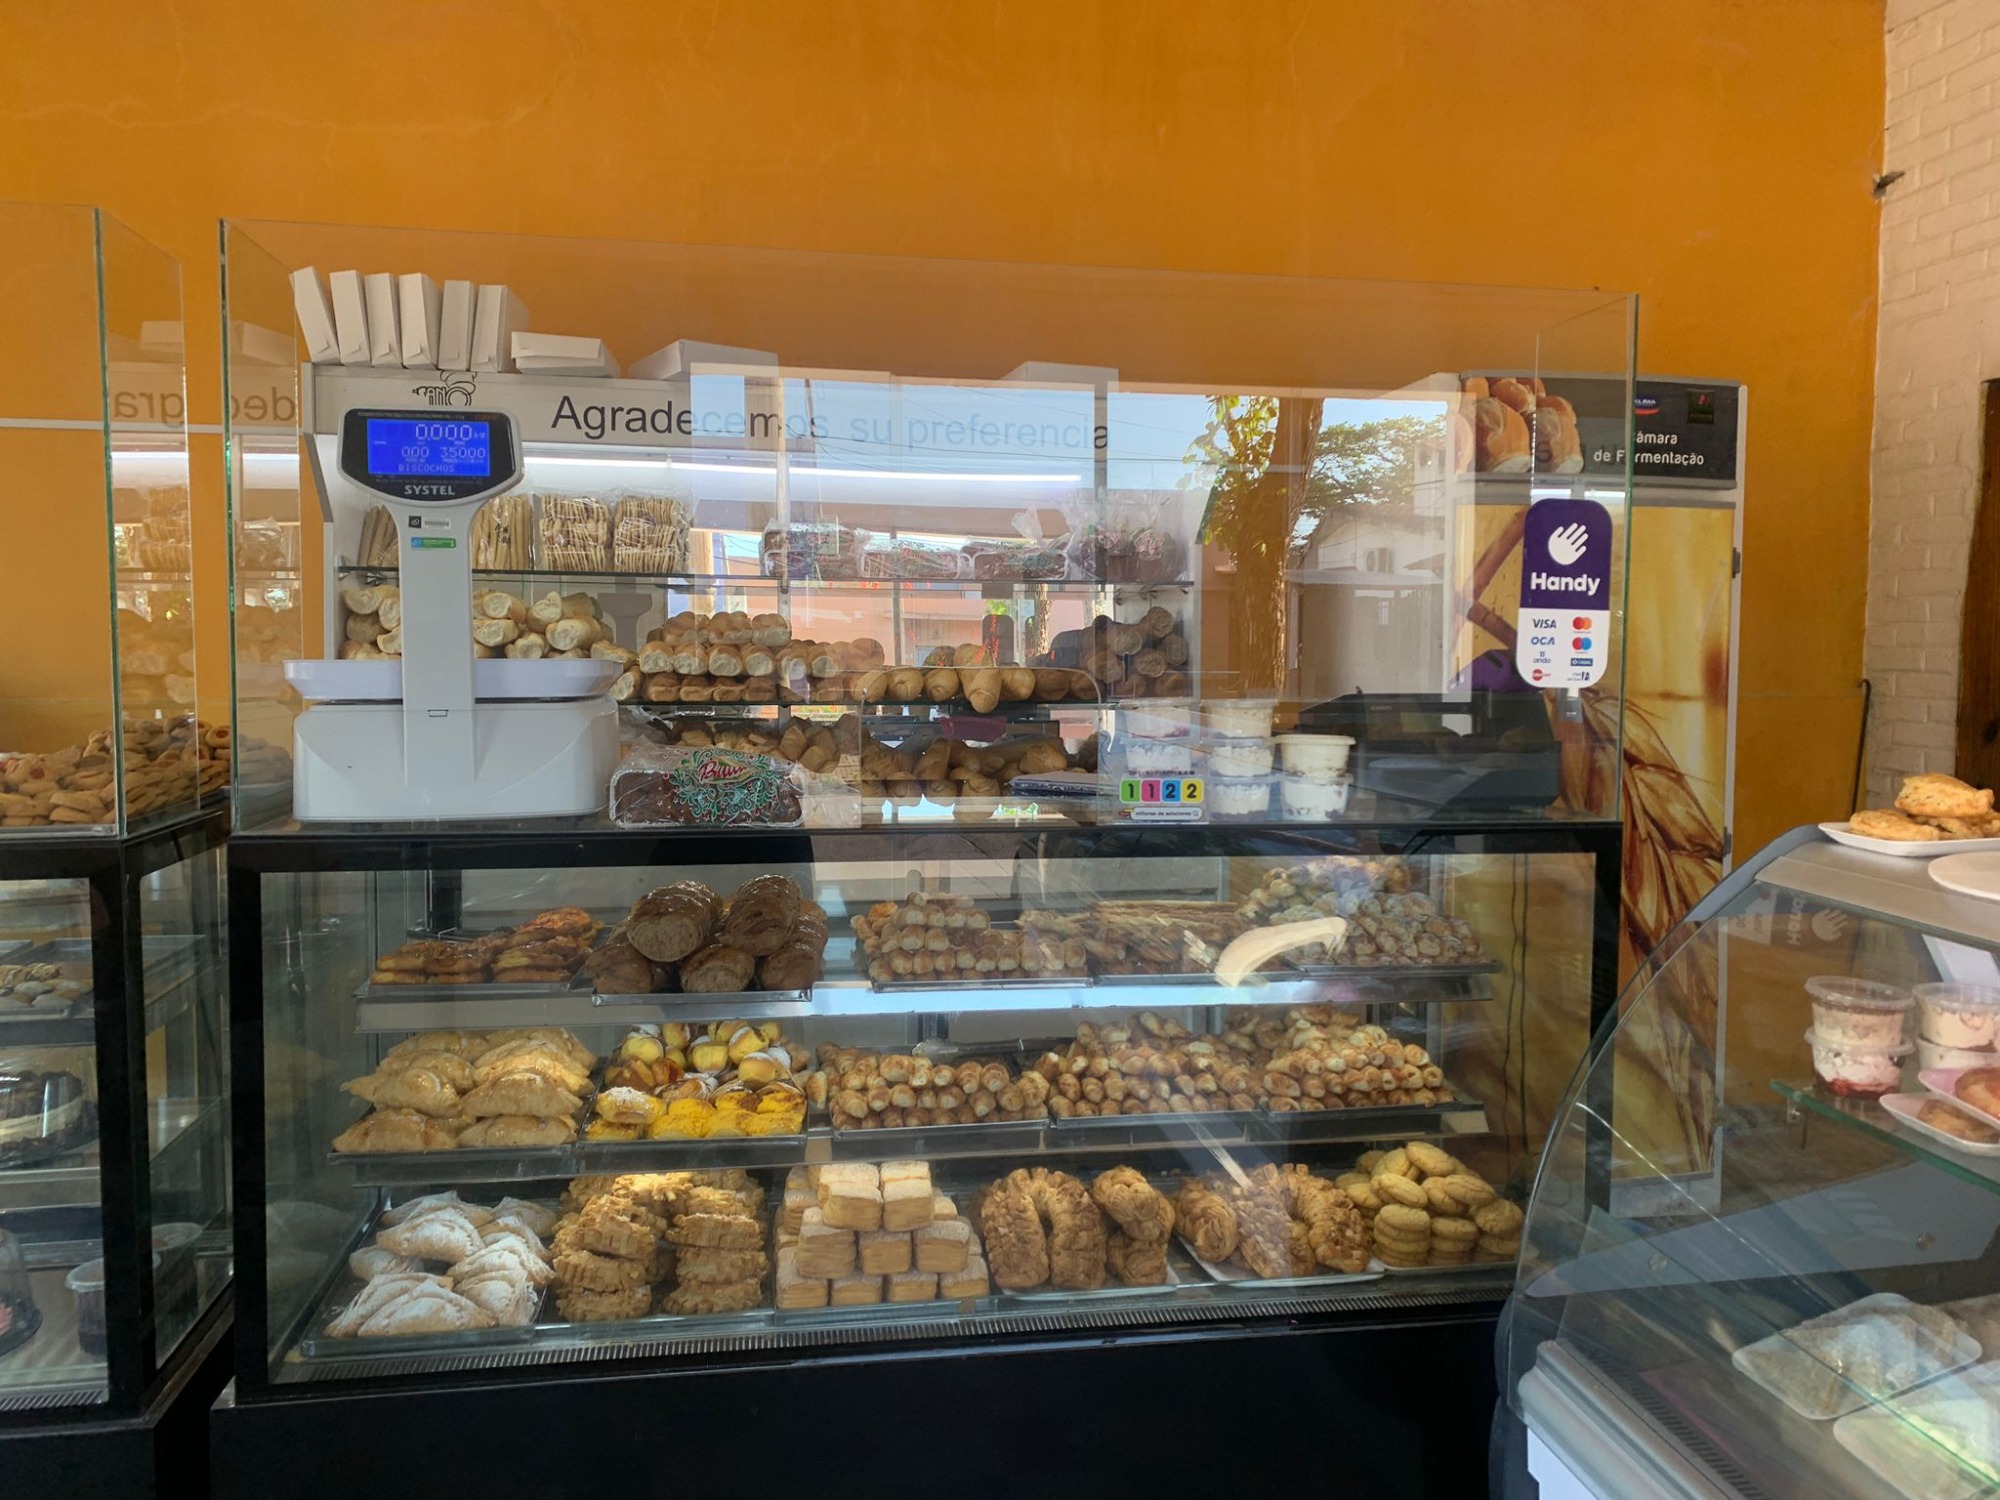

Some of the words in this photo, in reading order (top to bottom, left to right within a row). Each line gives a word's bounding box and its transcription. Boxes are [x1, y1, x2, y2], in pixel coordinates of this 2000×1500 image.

[551, 395, 829, 440] Agradecemos
[850, 417, 892, 443] su
[908, 414, 1107, 451] preferencia
[1634, 431, 1678, 445] âmara
[1594, 449, 1611, 462] de
[1616, 450, 1704, 466] Frmentação
[398, 463, 456, 473] BISCOCHOS
[404, 485, 455, 496] SYSTEL
[1530, 572, 1600, 596] Handy
[1532, 619, 1557, 629] VISA
[1531, 636, 1555, 646] OCA
